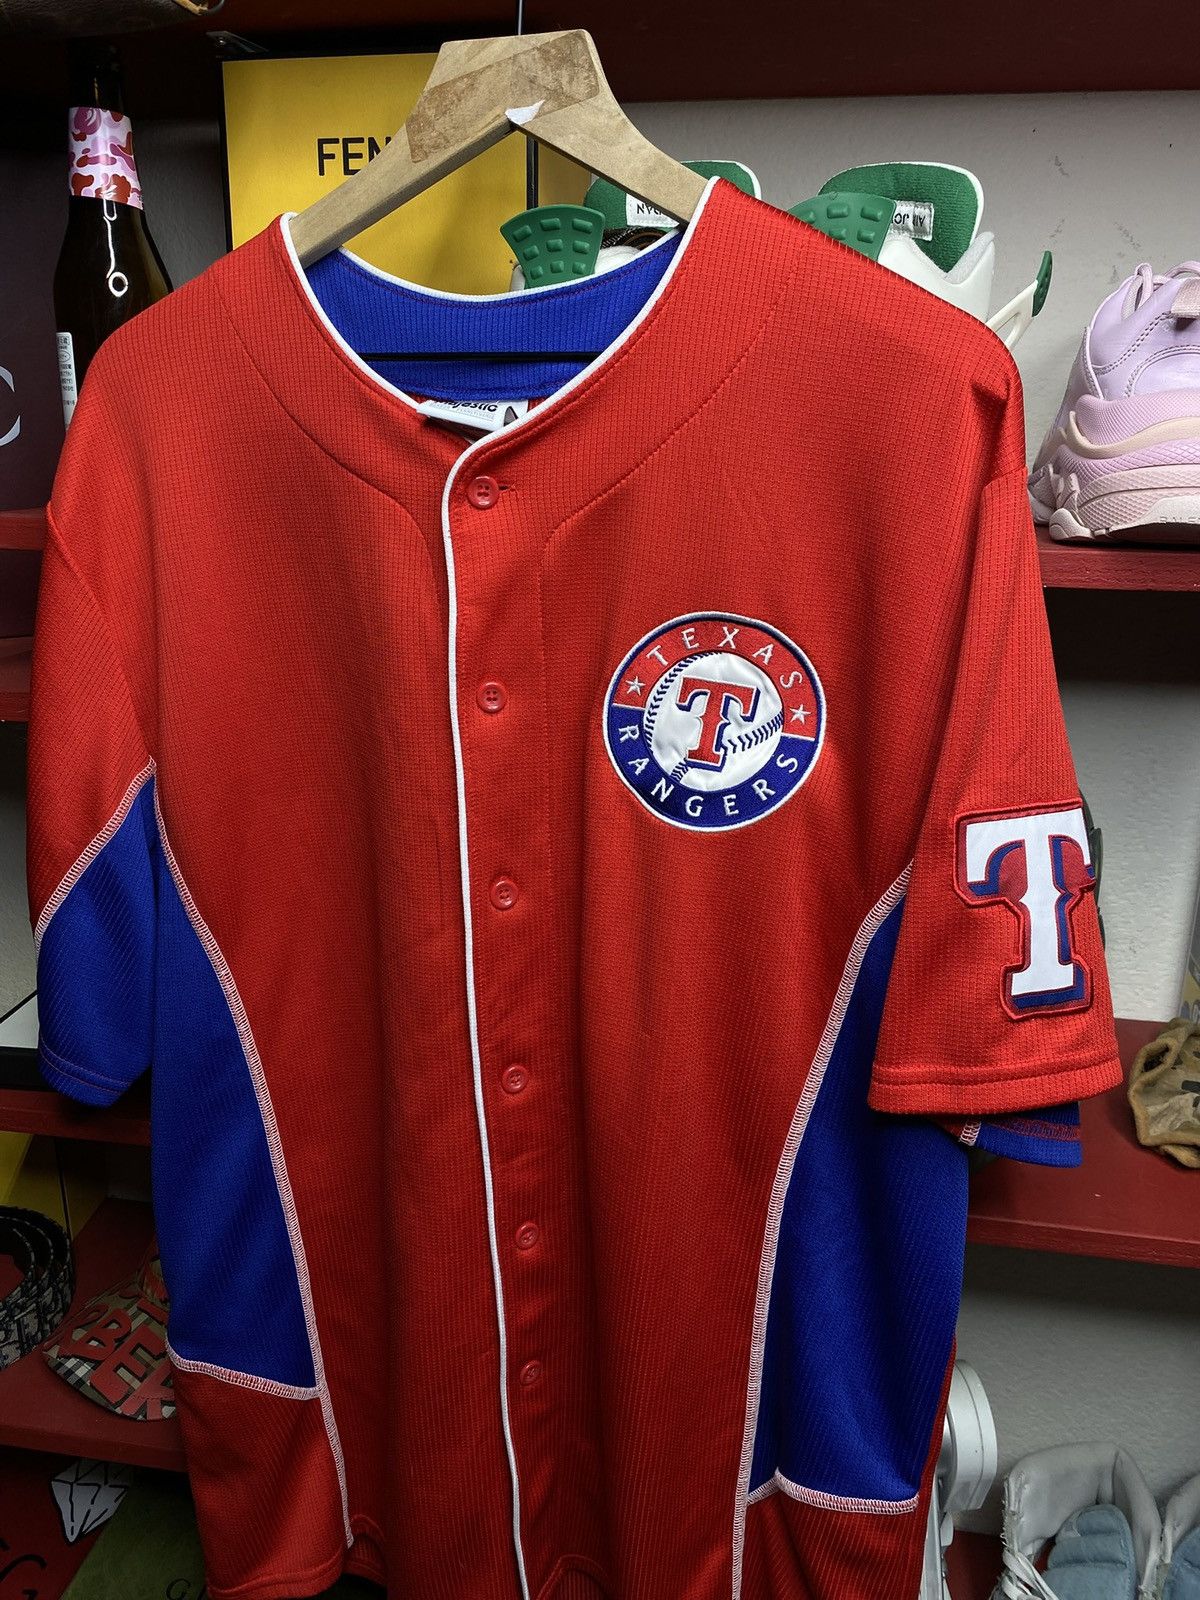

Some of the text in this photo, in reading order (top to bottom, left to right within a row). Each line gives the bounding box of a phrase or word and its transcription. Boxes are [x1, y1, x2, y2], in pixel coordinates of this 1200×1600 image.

[646, 626, 803, 689] TEXAS
[618, 723, 799, 818] RANGERS
[676, 675, 761, 773] T
[966, 807, 1095, 1010] T
